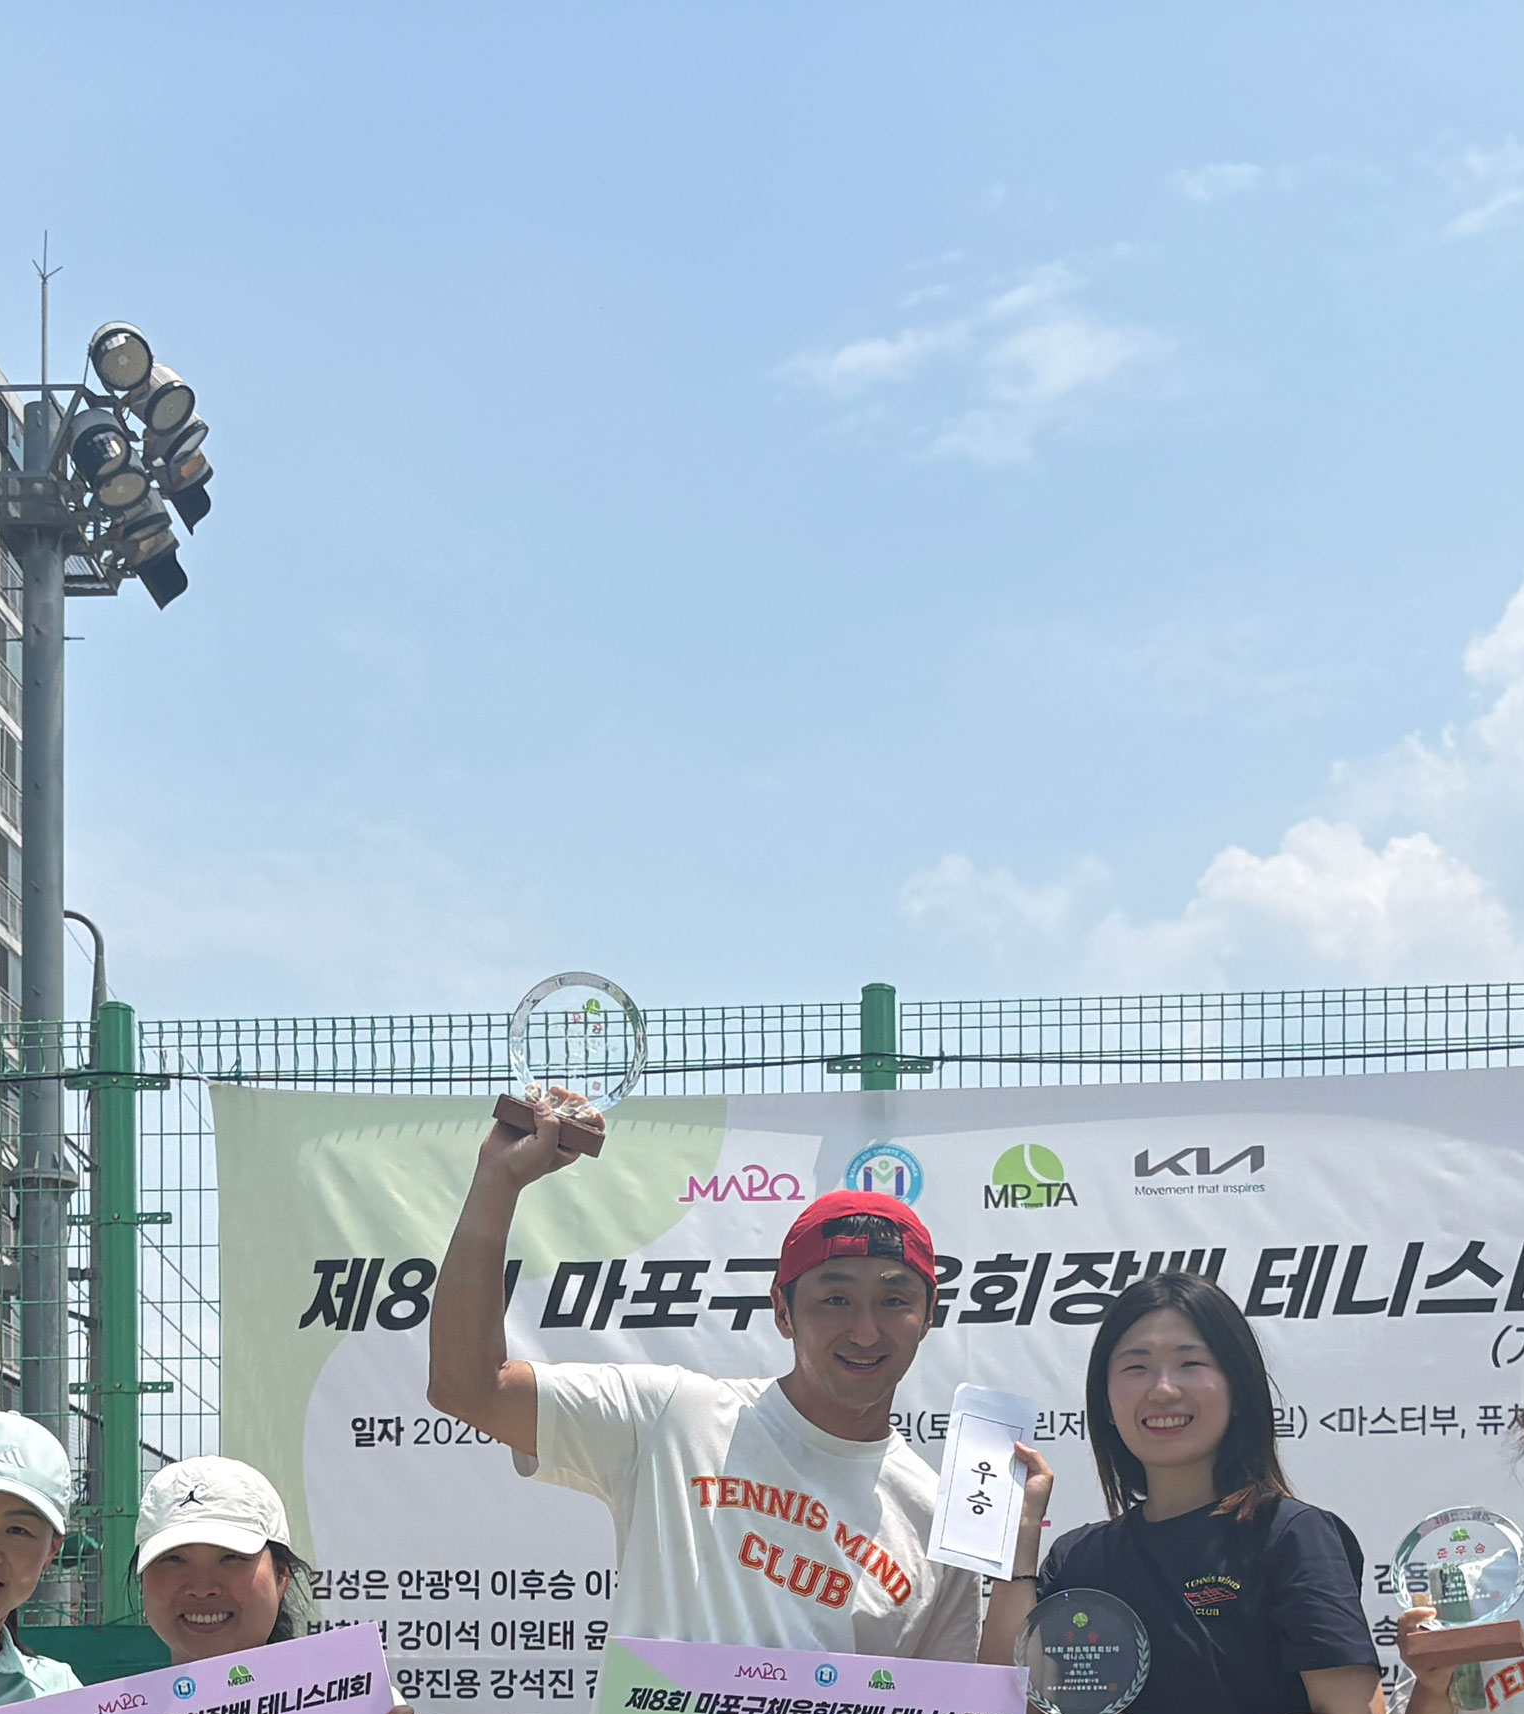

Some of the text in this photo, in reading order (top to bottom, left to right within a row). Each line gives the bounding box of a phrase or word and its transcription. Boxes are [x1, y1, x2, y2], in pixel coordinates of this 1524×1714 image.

[1134, 1182, 1266, 1196] Movement that inspires
[350, 1416, 405, 1448] 일자
[1319, 1404, 1466, 1440] <마스터부,
[965, 1460, 998, 1516] 우승
[690, 1475, 913, 1607] TENNIS MIND
[309, 1568, 390, 1601] 김성은
[396, 1568, 481, 1601] 안광익
[489, 1568, 577, 1601] 이후승
[737, 1531, 854, 1610] CLUB
[396, 1618, 481, 1651] 강이석
[489, 1618, 576, 1651] 이원태
[396, 1668, 481, 1700] 양진용
[489, 1668, 575, 1700] 강석진
[624, 1686, 691, 1713] 제8회
